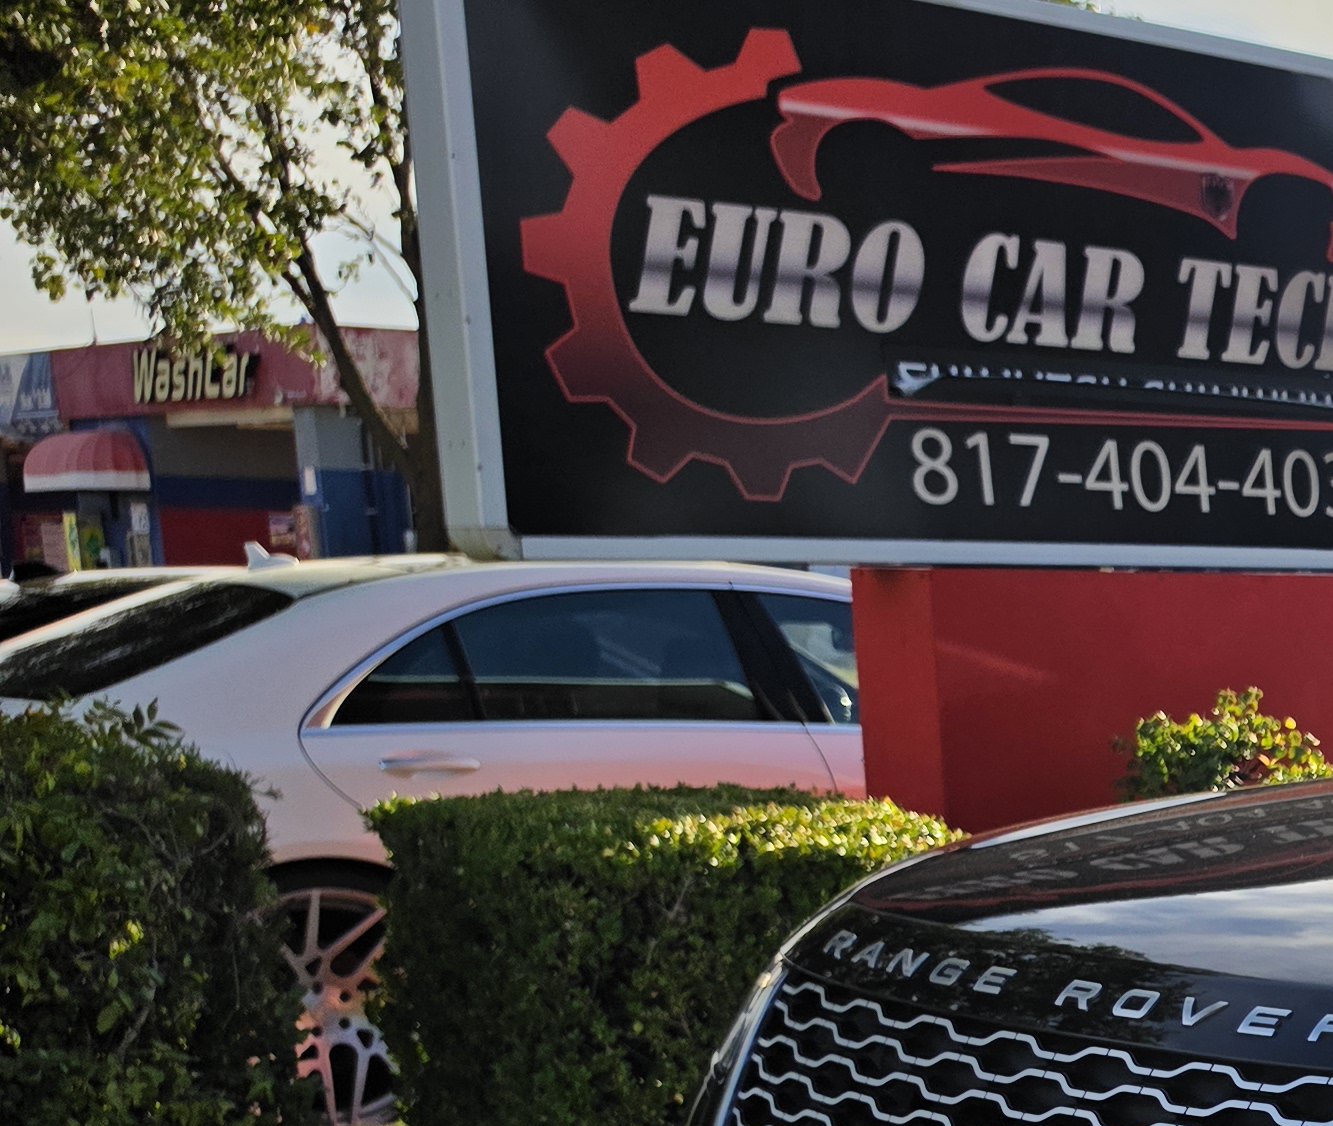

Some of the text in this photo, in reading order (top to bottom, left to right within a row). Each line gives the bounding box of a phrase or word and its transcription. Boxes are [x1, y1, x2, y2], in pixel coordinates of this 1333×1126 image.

[629, 195, 925, 333] EURO
[960, 231, 1145, 354] CAR
[823, 929, 1017, 995] RANGE
